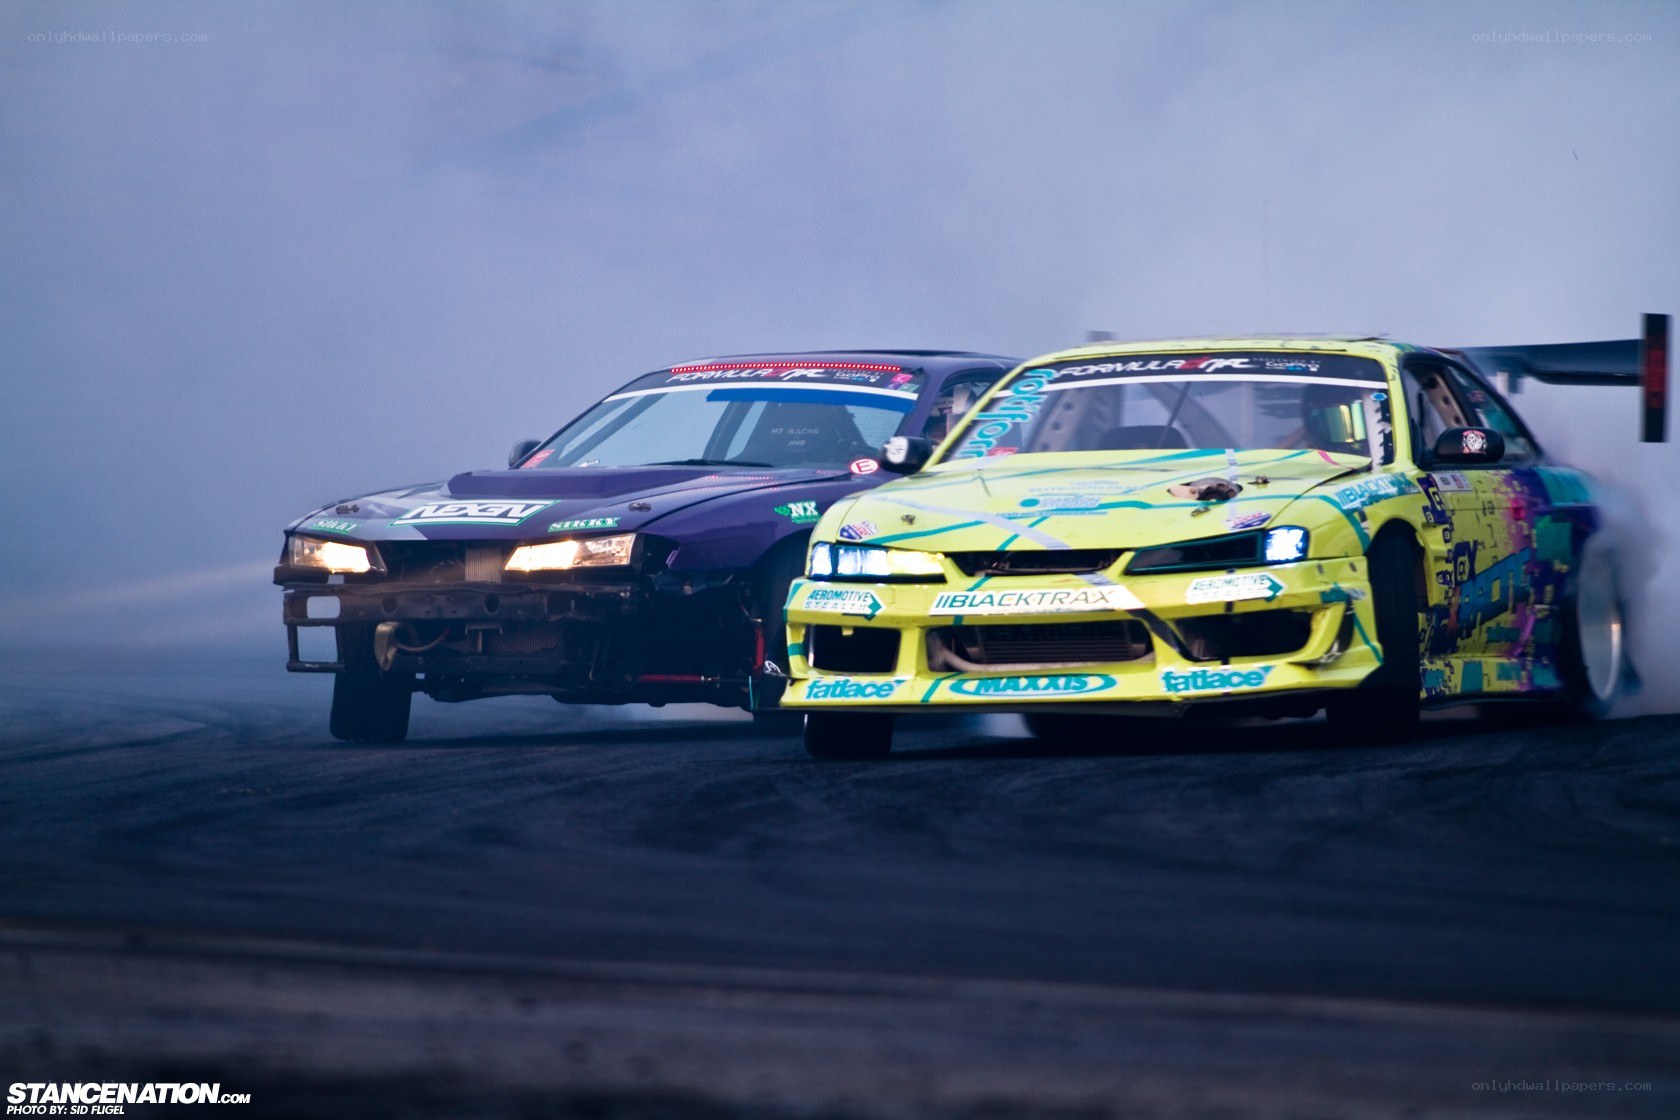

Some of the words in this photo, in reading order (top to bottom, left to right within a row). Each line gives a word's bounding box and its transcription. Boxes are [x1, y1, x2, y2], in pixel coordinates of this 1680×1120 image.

[788, 501, 818, 517] NX
[807, 589, 870, 602] AEROMOTIVE
[806, 678, 894, 699] fatlace
[974, 675, 1088, 694] MAXXIS
[1162, 669, 1264, 692] fatlace
